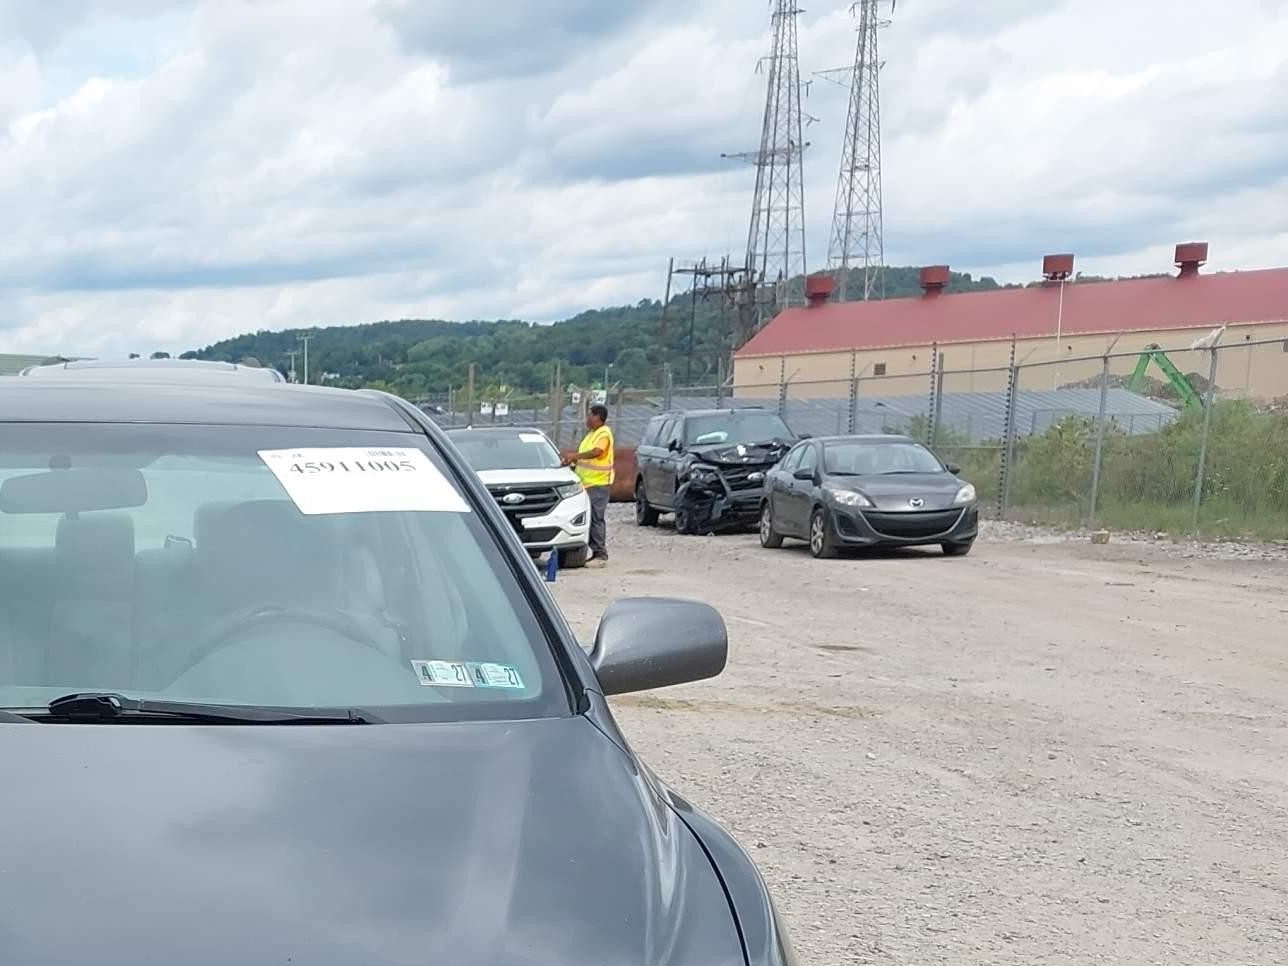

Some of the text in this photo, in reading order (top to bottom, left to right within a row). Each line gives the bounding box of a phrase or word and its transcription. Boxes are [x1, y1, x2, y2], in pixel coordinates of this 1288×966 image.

[289, 460, 416, 474] 45911005
[421, 664, 468, 682] 4 27
[475, 667, 520, 685] 4 27
